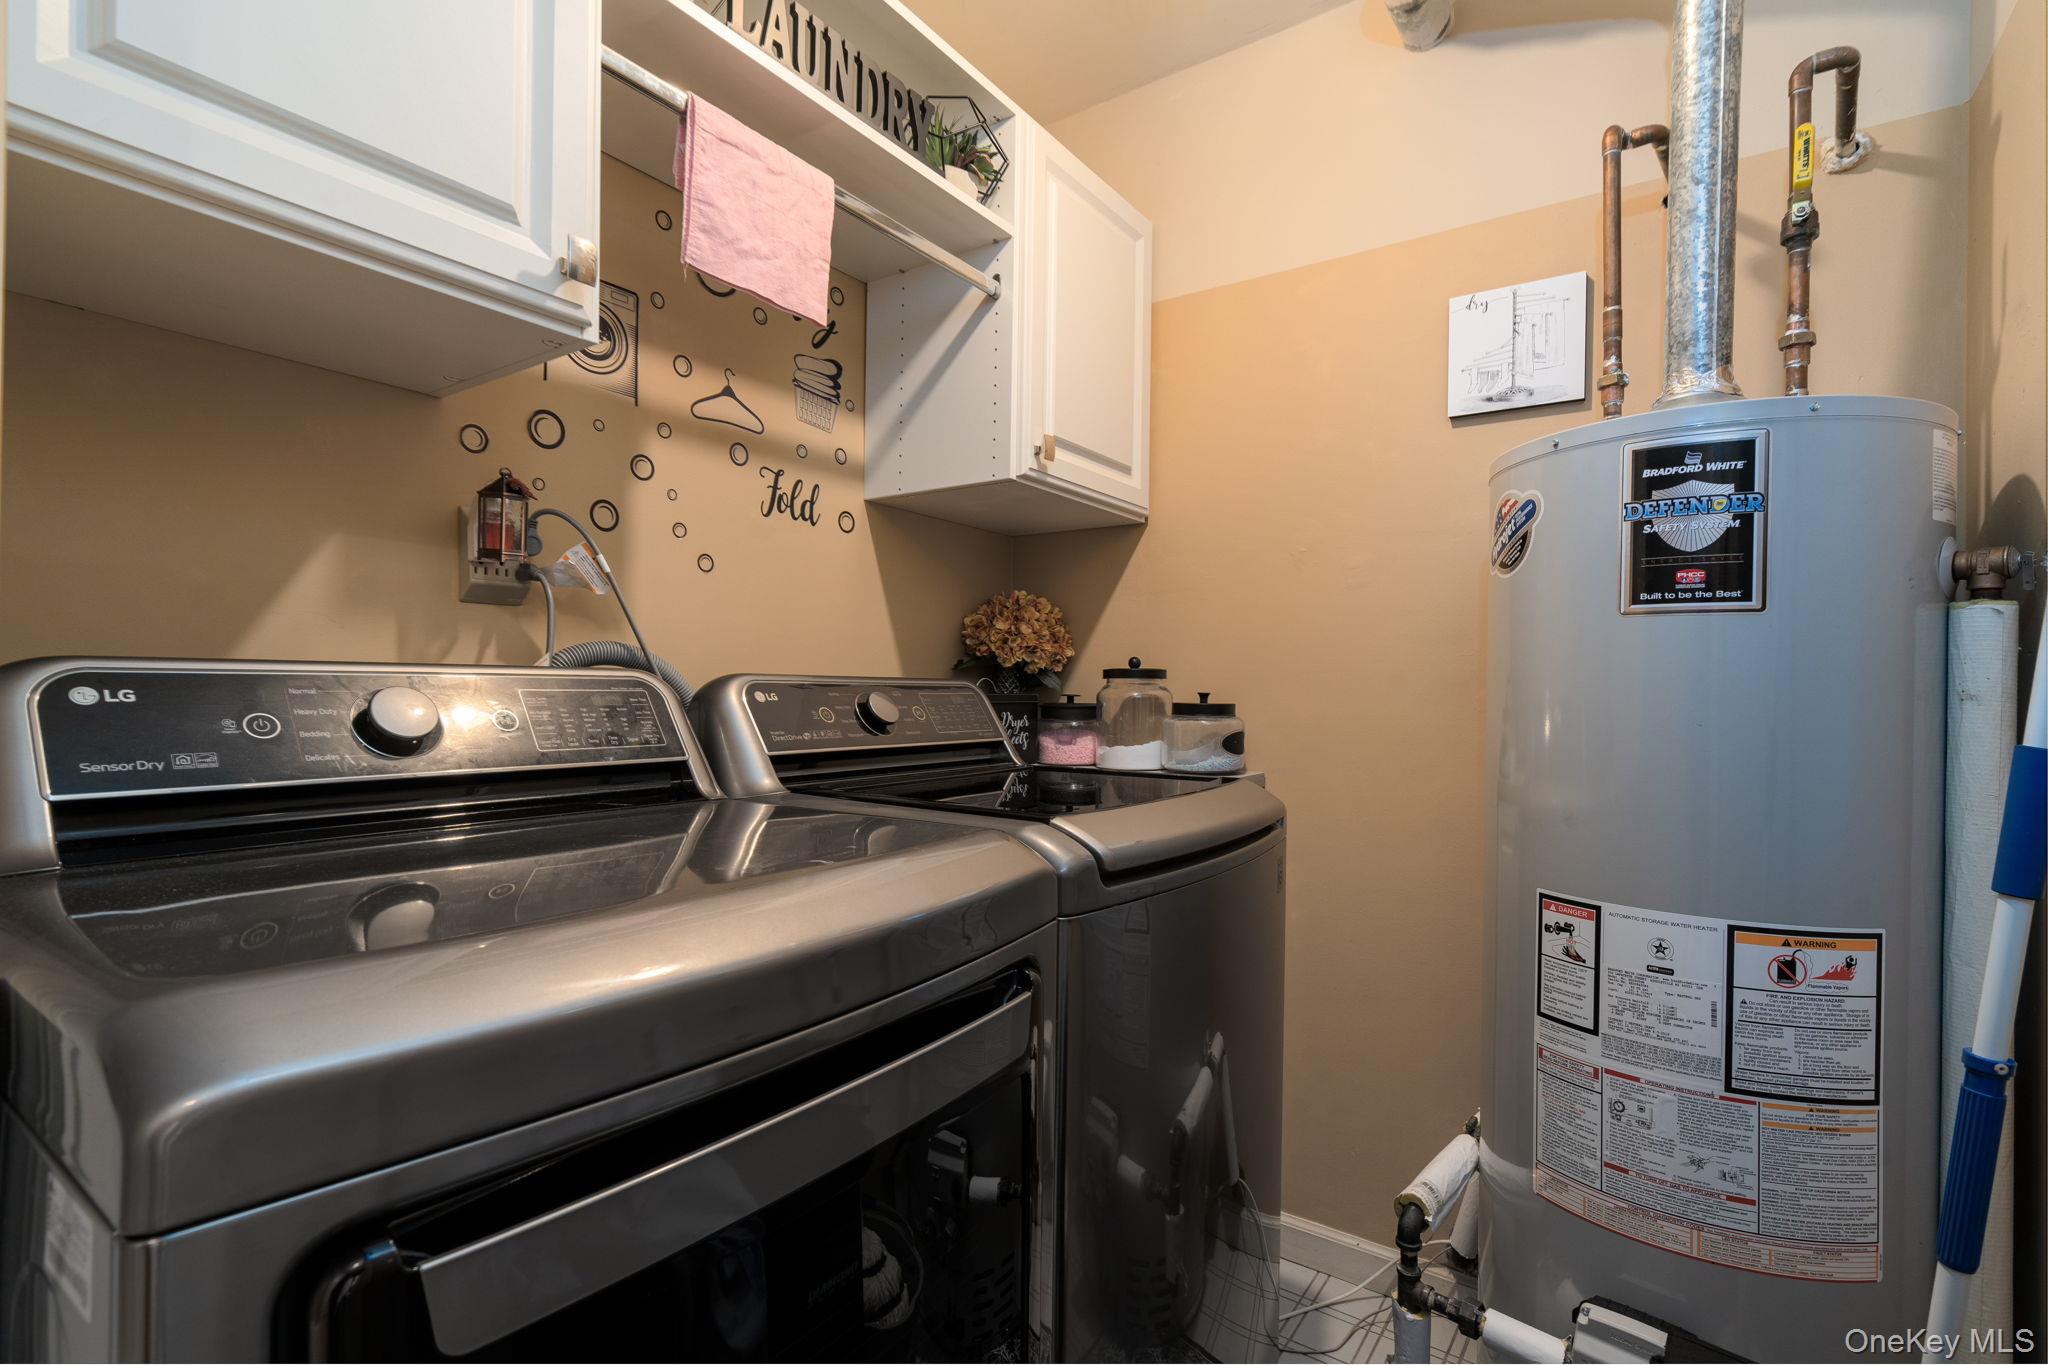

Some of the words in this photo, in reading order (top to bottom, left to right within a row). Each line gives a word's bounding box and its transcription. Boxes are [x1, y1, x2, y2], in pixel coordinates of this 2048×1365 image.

[724, 0, 936, 154] LAUNDRY
[1642, 464, 1703, 478] BRADFORD
[1706, 461, 1745, 472] WHITE
[759, 466, 821, 527] Fold
[1624, 492, 1765, 521] DEFENDER
[1642, 522, 1688, 534] SAFETY
[1690, 519, 1741, 530] SYSTEM
[1640, 592, 1662, 600] Built
[1678, 591, 1692, 599] be
[1695, 590, 1713, 598] the
[1716, 590, 1741, 598] Best
[103, 689, 137, 702] LG
[765, 692, 778, 701] LG
[293, 708, 317, 716] Heavy
[319, 708, 337, 716] Duty
[1001, 711, 1029, 734] Dryer
[1558, 905, 1588, 918] DANGER
[1608, 911, 1641, 922] AUTOMATIC
[1641, 917, 1669, 926] STORAGE
[1671, 921, 1692, 929] WATER
[1693, 924, 1718, 932] HEATER
[1794, 940, 1837, 949] WARNING
[1645, 1079, 1675, 1090] OPERATING
[1675, 1086, 1715, 1097] INSTRUCTIONS
